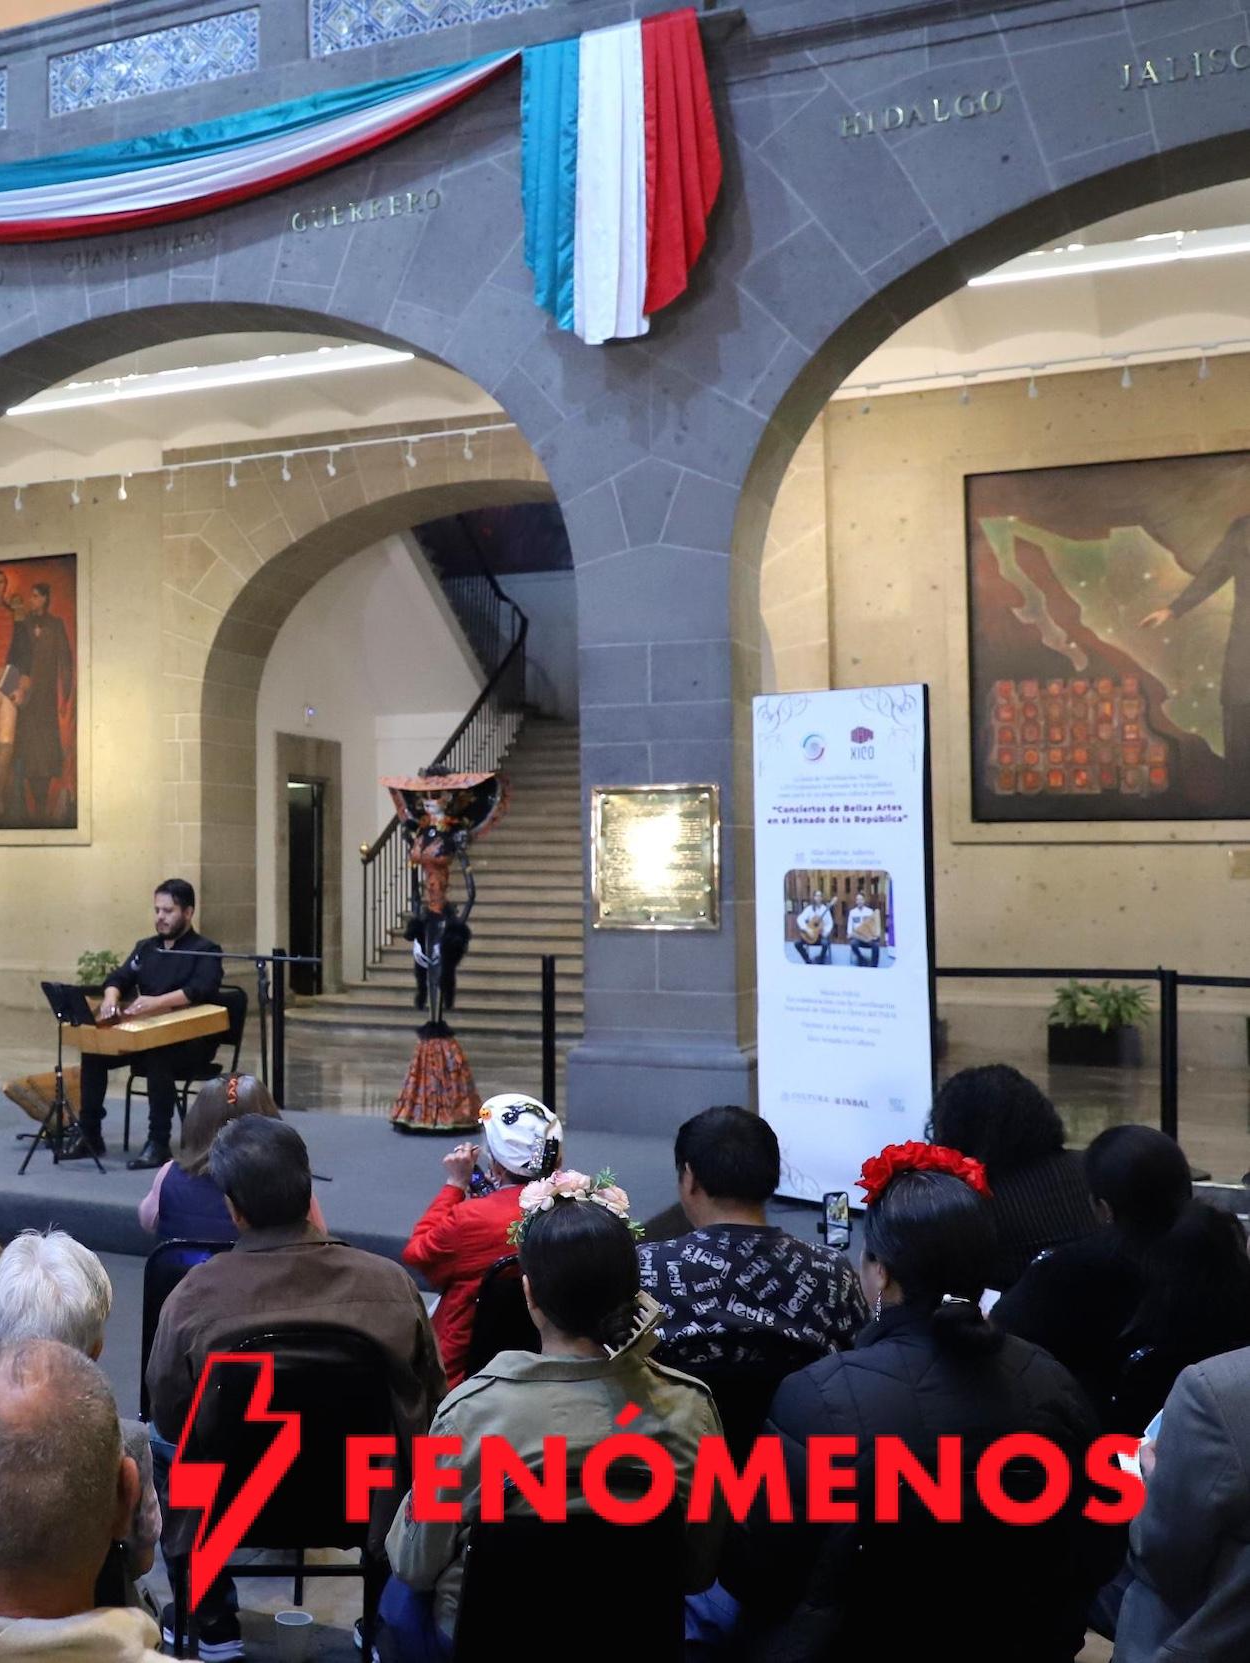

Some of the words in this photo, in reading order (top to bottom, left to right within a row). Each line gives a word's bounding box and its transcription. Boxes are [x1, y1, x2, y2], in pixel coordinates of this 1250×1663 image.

[840, 88, 1004, 139] HIDALGO
[290, 188, 442, 233] GUERRERO
[850, 746, 874, 760] XICO
[829, 804, 840, 812] de
[844, 804, 872, 813] Bellas
[876, 803, 902, 811] Artes
[767, 817, 779, 825] en
[781, 816, 790, 825] el
[793, 816, 826, 825] Senado
[828, 816, 840, 824] de
[843, 815, 851, 824] la
